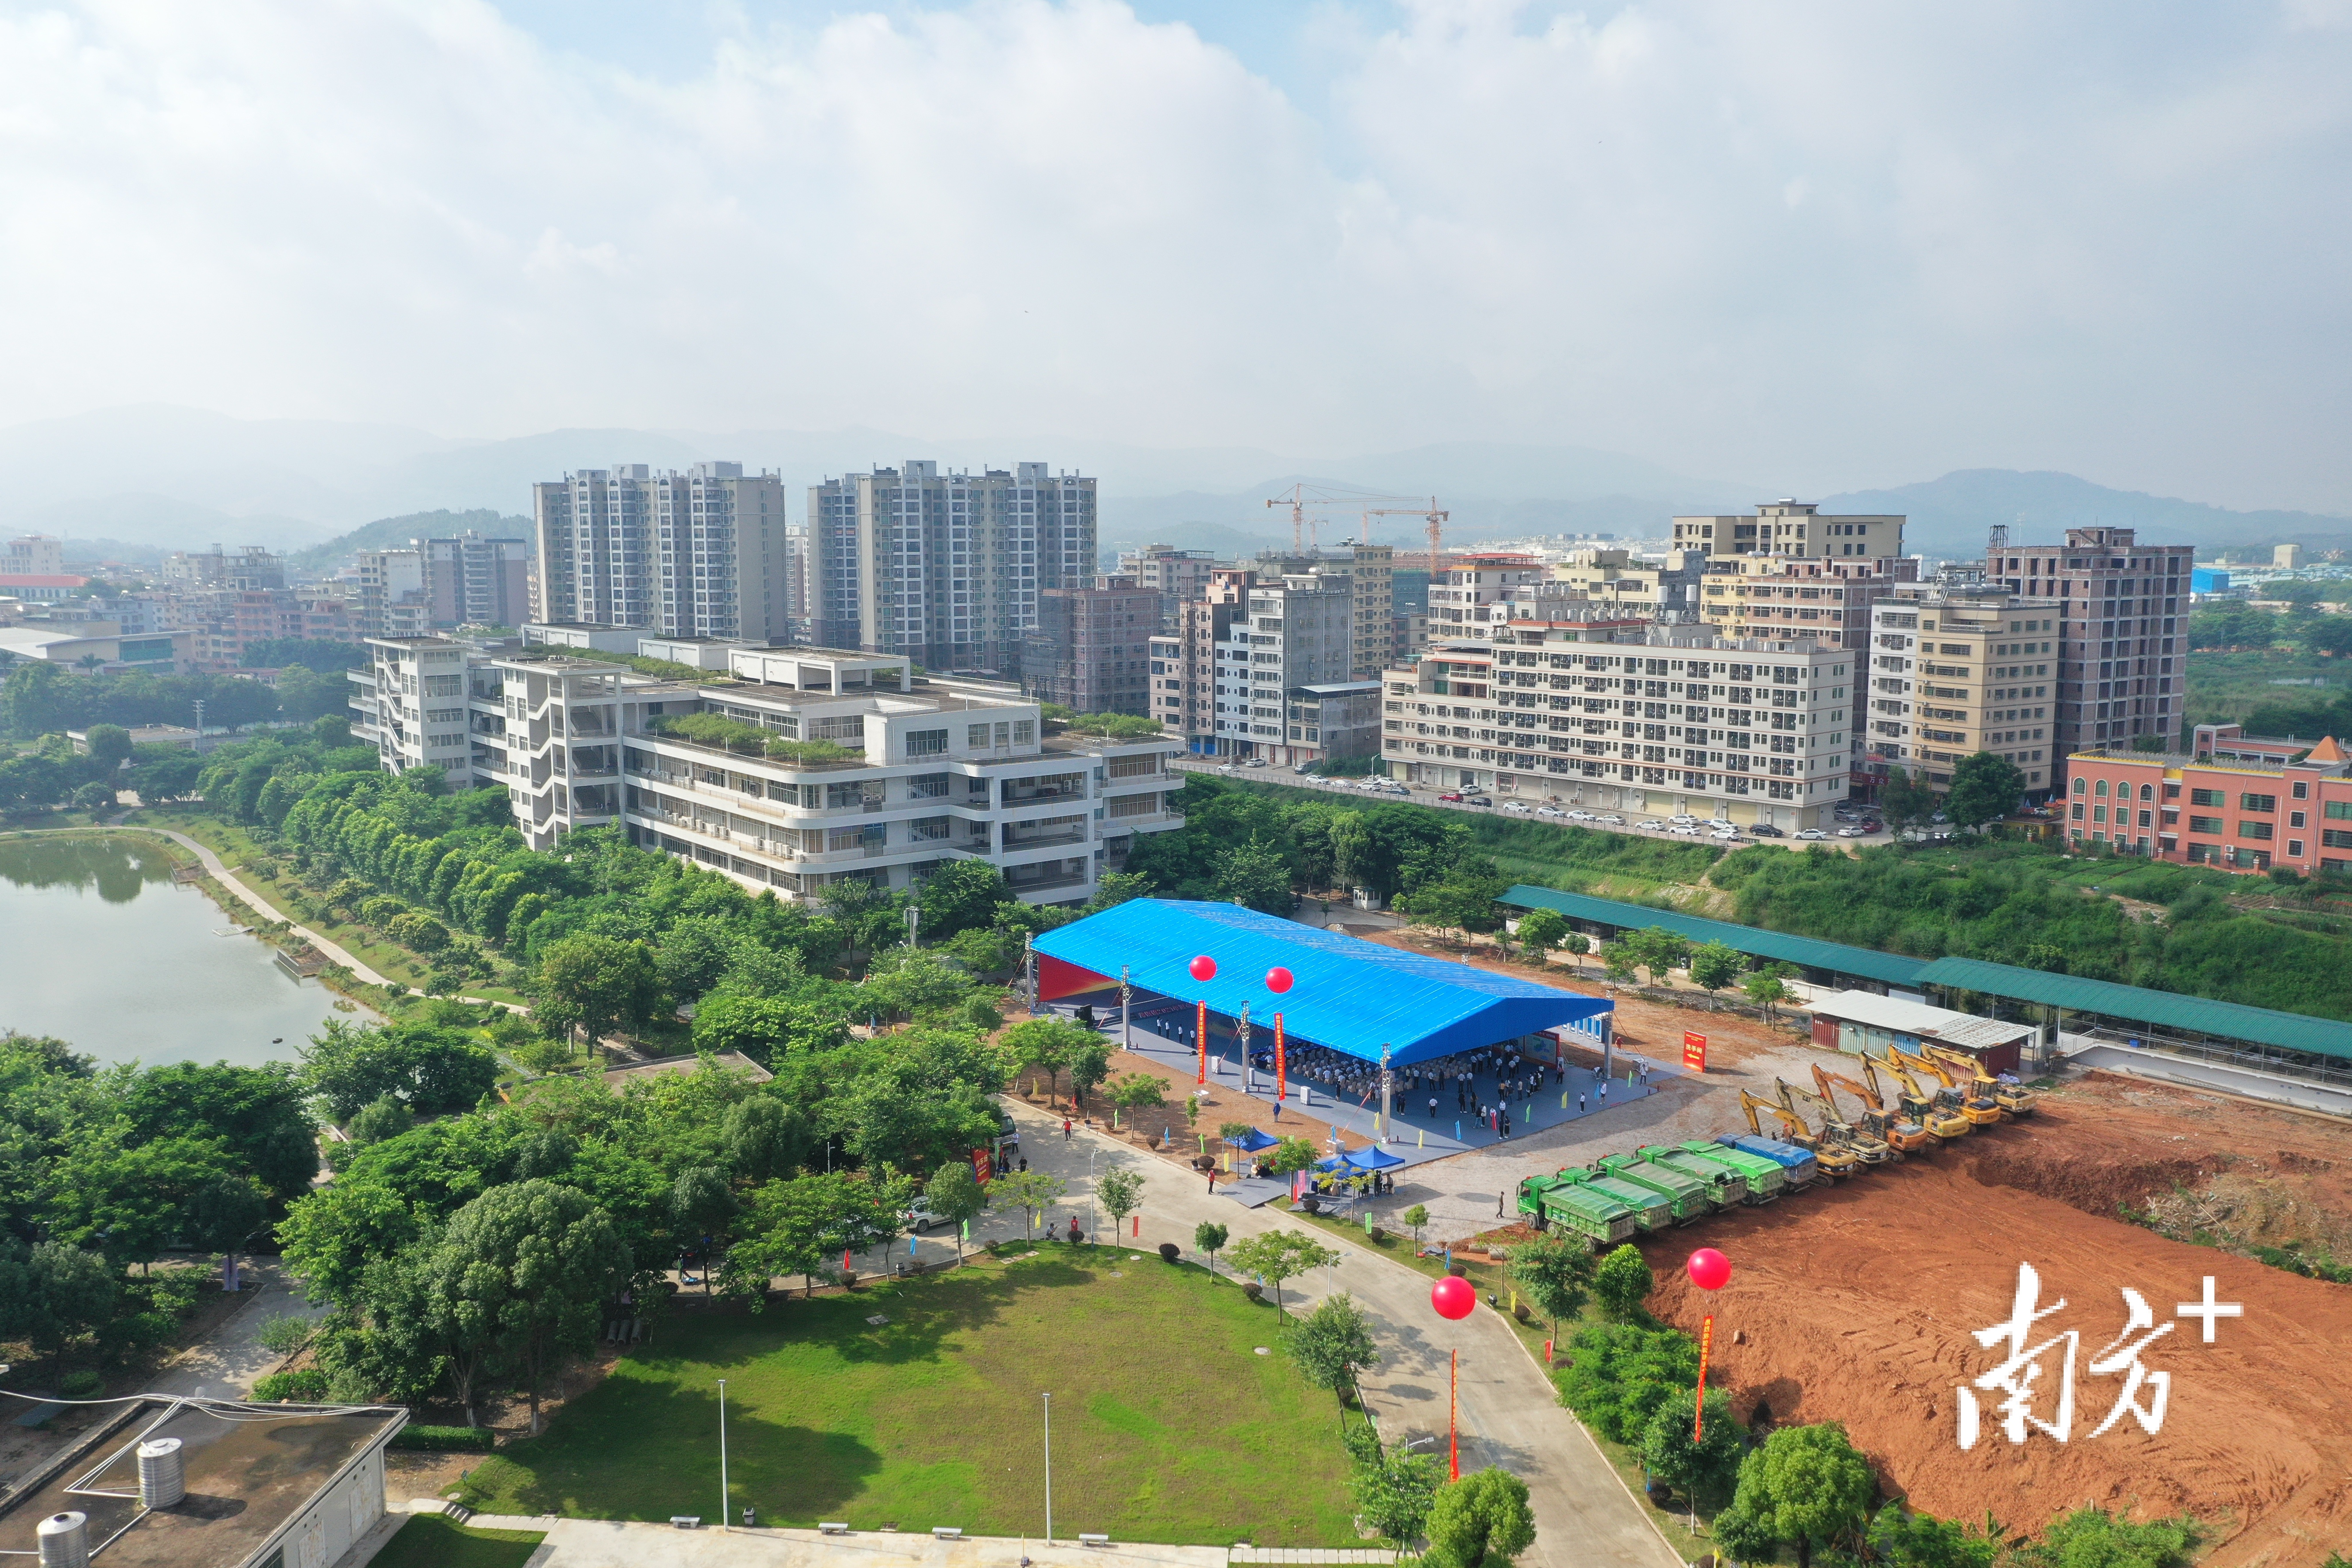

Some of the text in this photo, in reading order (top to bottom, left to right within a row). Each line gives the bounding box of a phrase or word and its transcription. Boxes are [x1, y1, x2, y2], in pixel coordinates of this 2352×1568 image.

[1869, 776, 1891, 785] 万众
[1686, 1044, 1702, 1054] 洗手间
[976, 1155, 988, 1168] 停车场
